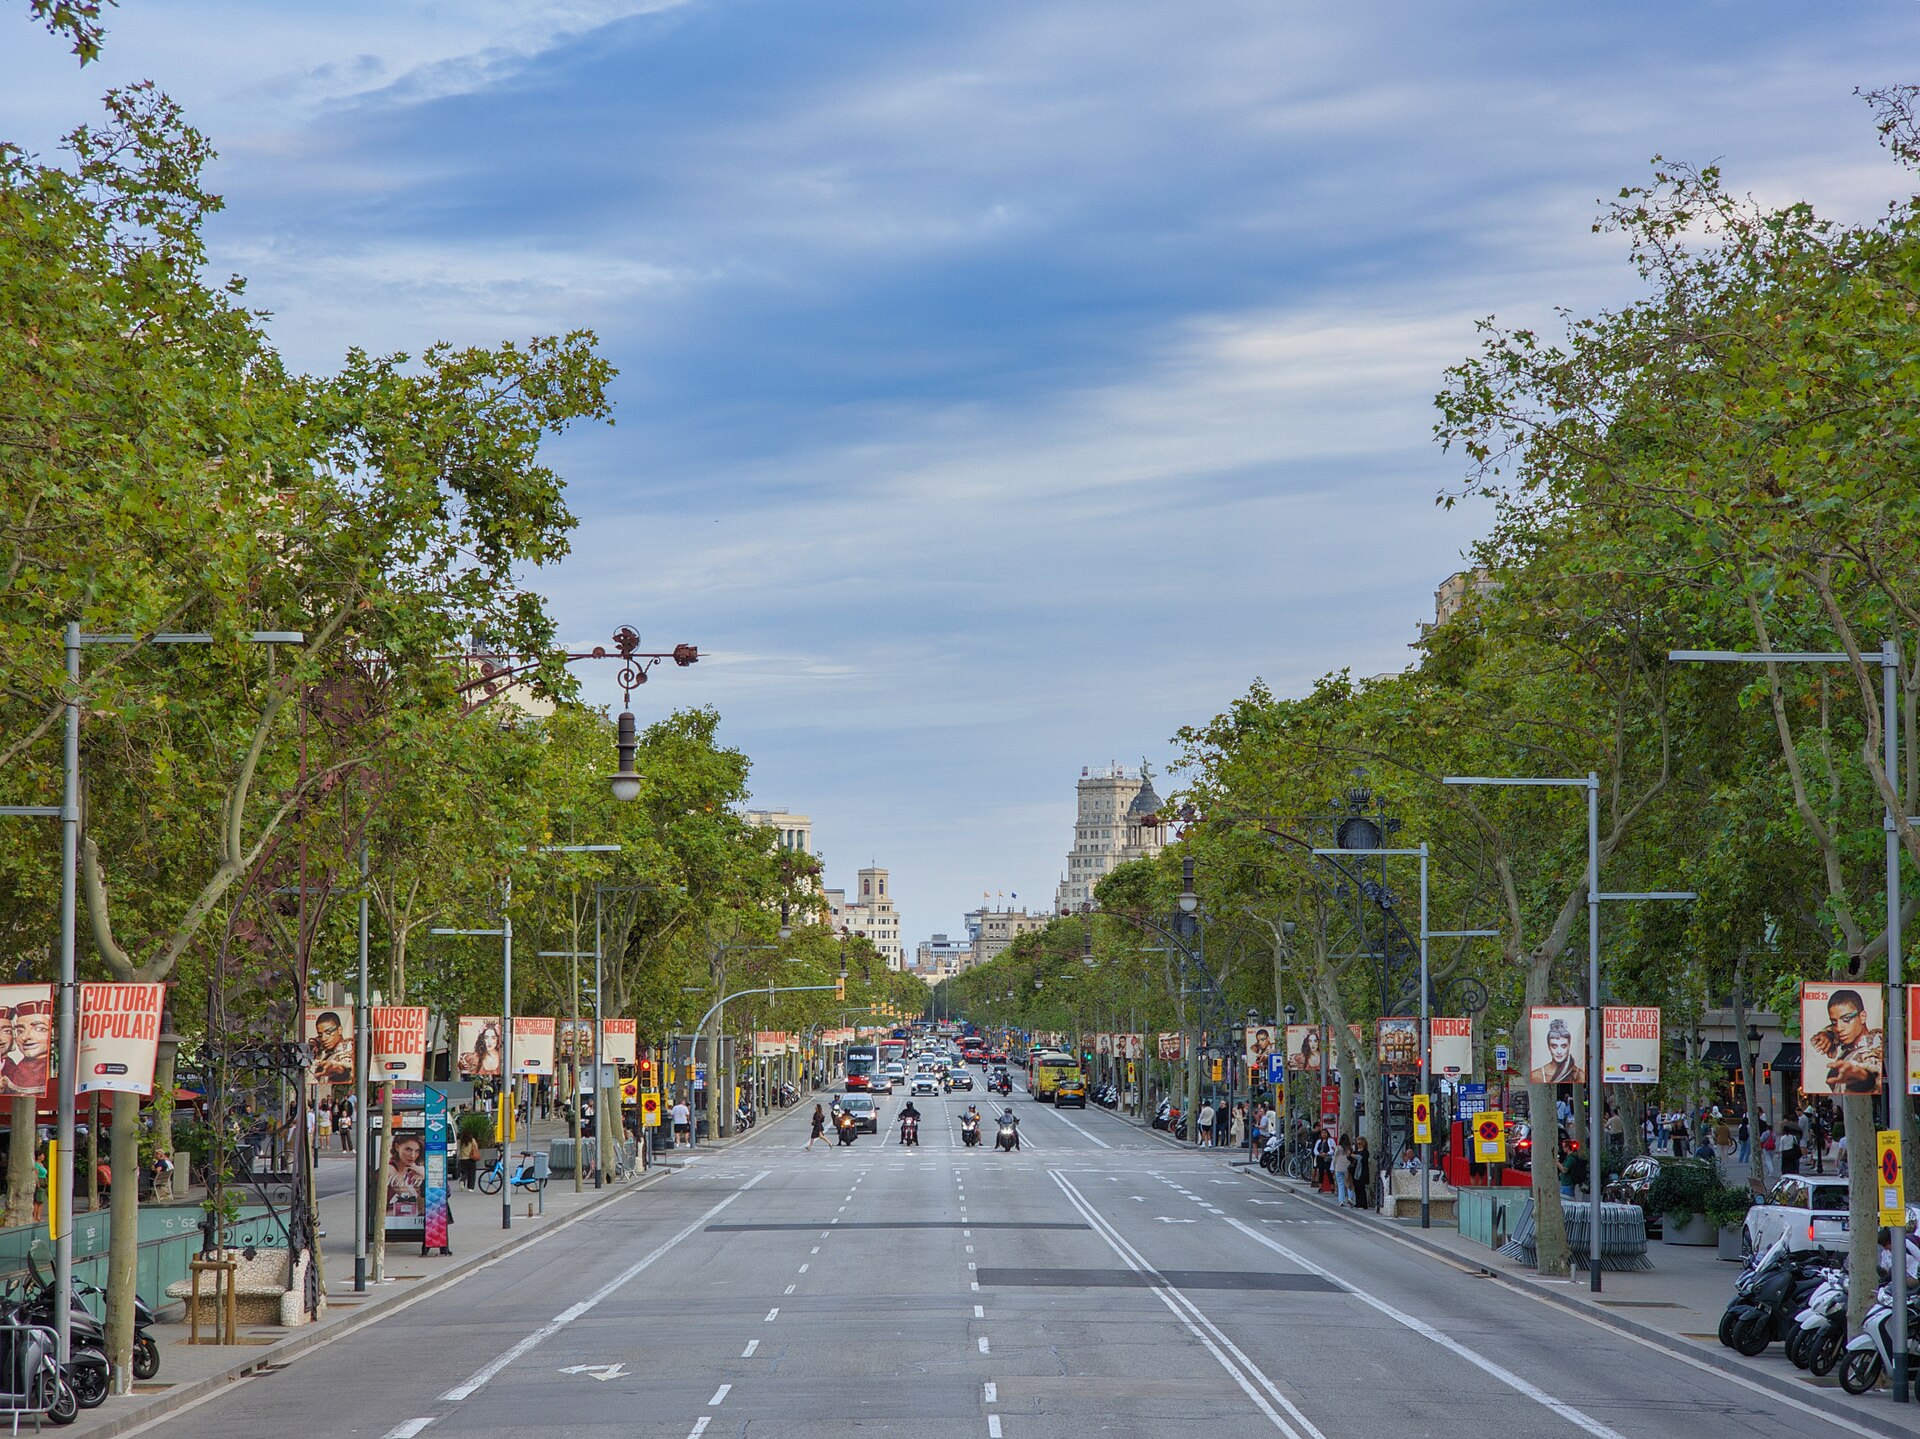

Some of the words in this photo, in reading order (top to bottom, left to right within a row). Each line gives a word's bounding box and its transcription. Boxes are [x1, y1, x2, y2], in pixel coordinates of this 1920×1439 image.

[83, 986, 158, 1012] CULTURA
[515, 1019, 553, 1028] MANCHESTER
[1635, 1009, 1658, 1024] ARTS
[80, 1013, 156, 1040] POPULAR
[1605, 1023, 1618, 1039] DE
[1619, 1023, 1658, 1040] CARRER
[1272, 1056, 1283, 1071] P
[1460, 1086, 1467, 1094] P
[414, 1217, 425, 1225] DI
